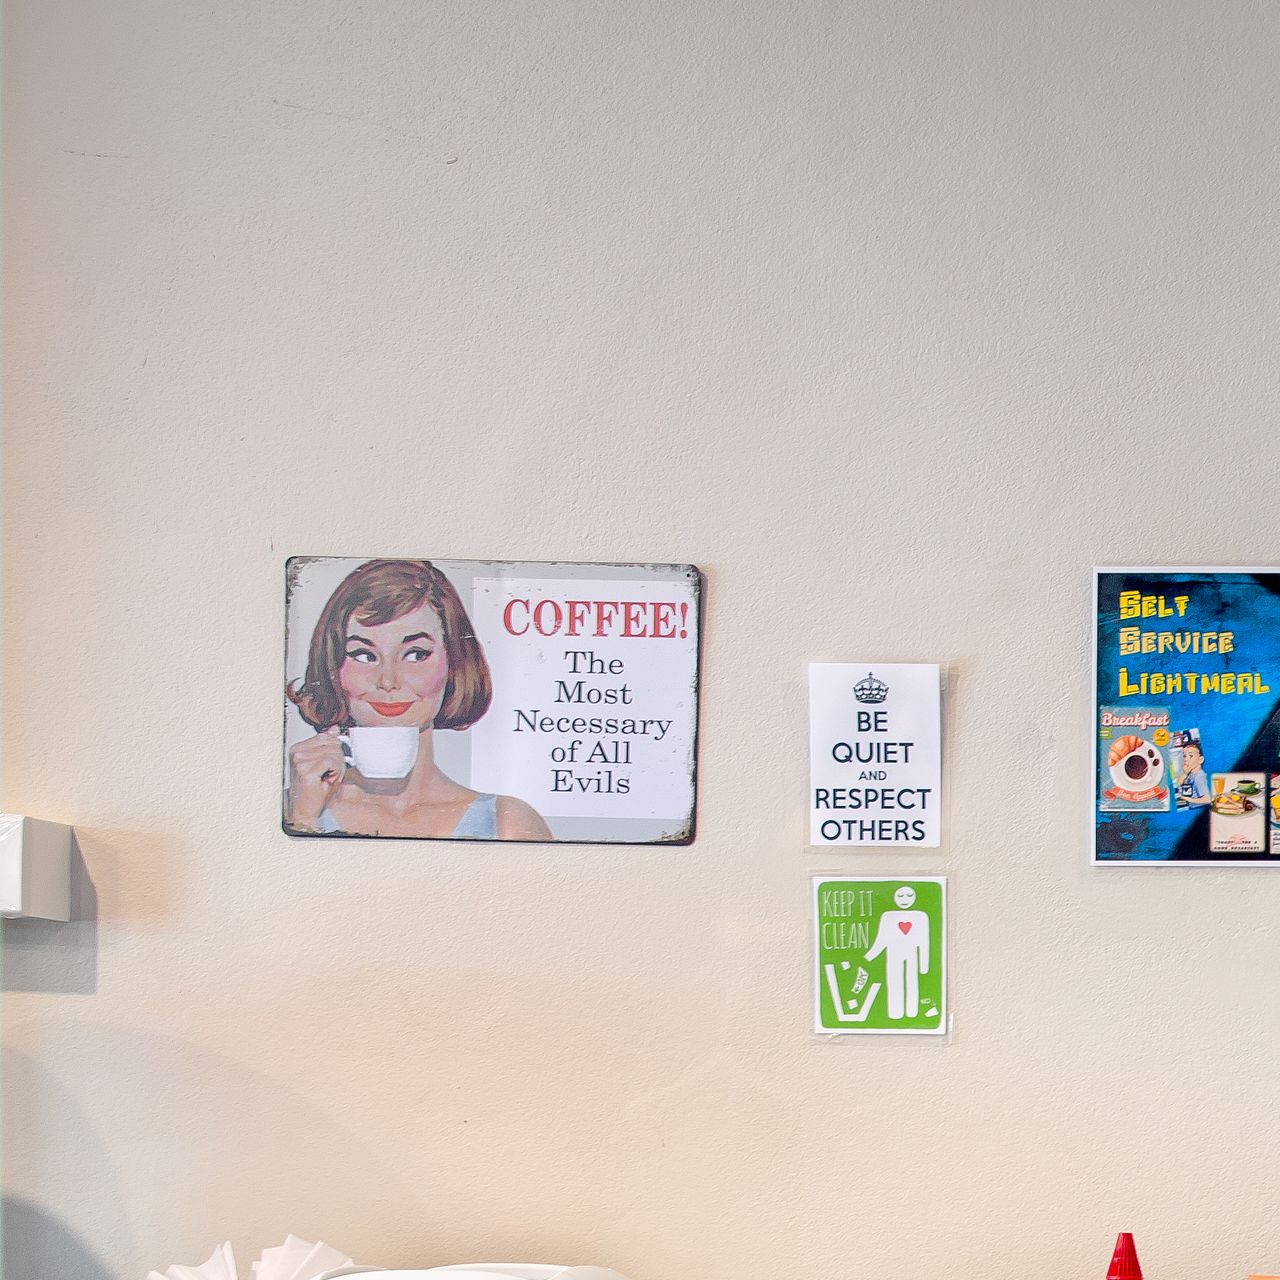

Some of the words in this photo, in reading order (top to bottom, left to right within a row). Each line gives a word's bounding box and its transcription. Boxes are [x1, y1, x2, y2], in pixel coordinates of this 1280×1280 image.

[503, 599, 689, 640] COFFEE!
[1119, 626, 1234, 656] SERVICE
[564, 650, 625, 675] The
[554, 680, 633, 705] Most
[1118, 667, 1271, 697] LIGHTMEAL
[513, 710, 672, 740] Necessary
[857, 711, 888, 732] BE
[1101, 711, 1170, 731] Breakfast
[551, 740, 582, 764] of
[585, 741, 632, 765] All
[831, 742, 914, 764] QUIET
[550, 769, 631, 795] Evils
[858, 770, 887, 781] AND
[815, 788, 931, 809] RESPECT
[821, 819, 926, 841] OTHERS
[822, 890, 855, 917] KEEP
[858, 890, 874, 917] IT
[822, 922, 870, 950] CLEAN
